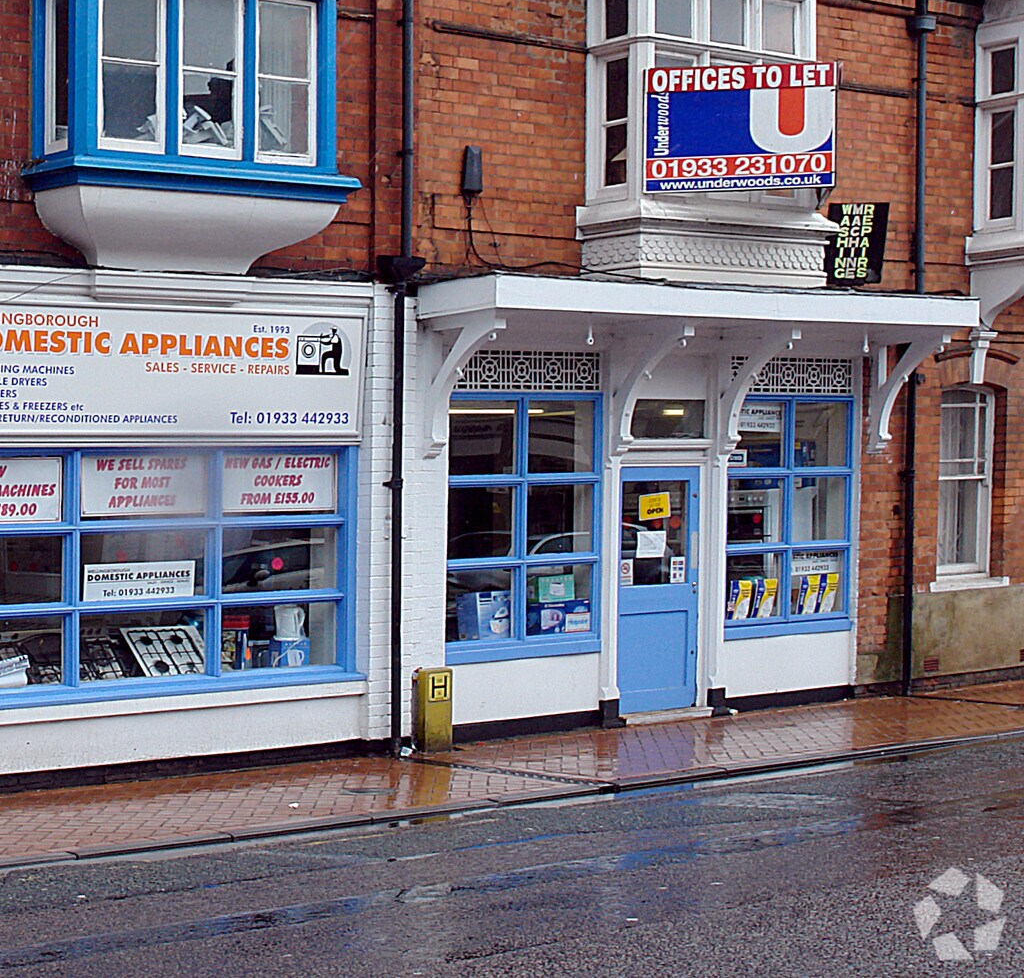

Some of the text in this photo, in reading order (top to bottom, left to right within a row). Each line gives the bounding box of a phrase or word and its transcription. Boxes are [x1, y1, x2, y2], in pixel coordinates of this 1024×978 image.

[652, 64, 830, 92] OFFICES TO LET
[651, 154, 826, 178] 01933 231070
[660, 174, 821, 190] www.underwoods.co.uk
[253, 325, 290, 334] Est. 1993
[119, 333, 290, 359] APPLIANCES
[23, 365, 75, 375] MACHINES
[145, 362, 179, 373] SALES
[191, 363, 236, 374] SERVICE
[247, 364, 290, 375] REPAIRS
[11, 377, 47, 386] DRYERS
[13, 402, 19, 410] &
[23, 402, 68, 411] FREEZERS
[70, 403, 84, 411] etc
[122, 415, 178, 423] APPLIANCES
[230, 412, 349, 424] Tel: 01933 442933
[96, 457, 188, 471] WE SELL SPARES
[224, 457, 250, 469] NEW
[251, 457, 273, 469] GAS
[284, 456, 330, 469] ELECTRIC
[114, 476, 171, 489] FOR MOST
[254, 474, 303, 487] COOKERS
[108, 494, 176, 508] APPLIANCES
[240, 492, 315, 505] FROM £155.00
[87, 570, 191, 582] DOMESTIC APPLIANCES
[103, 586, 175, 597] Tel: 01933 442933
[432, 675, 447, 698] H
